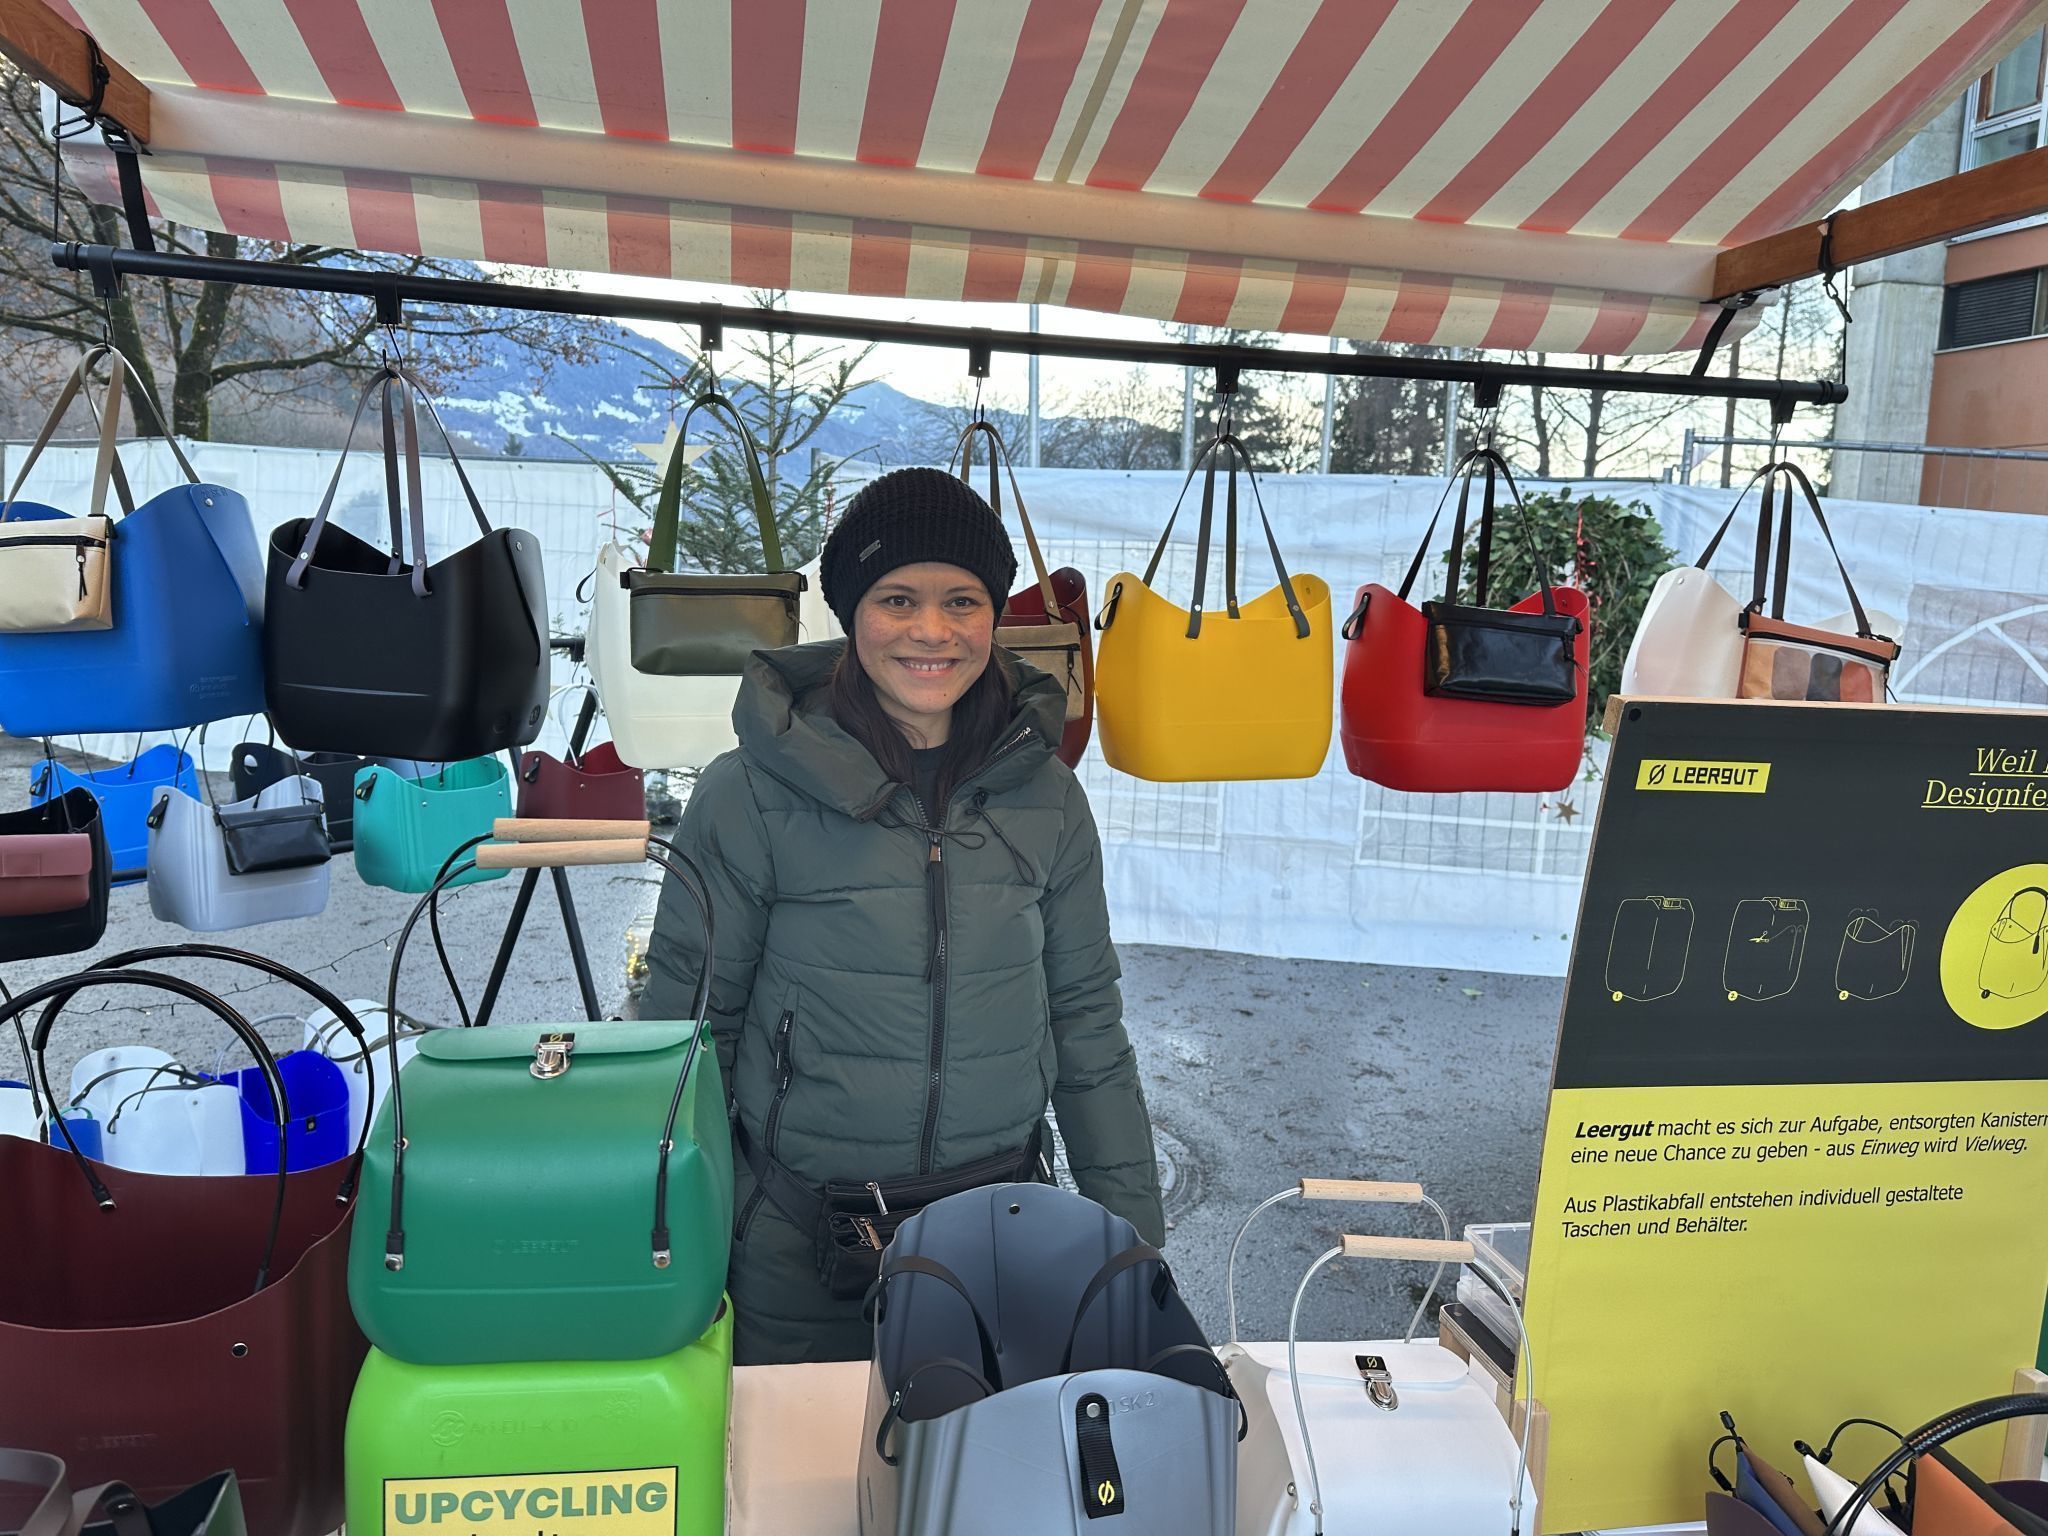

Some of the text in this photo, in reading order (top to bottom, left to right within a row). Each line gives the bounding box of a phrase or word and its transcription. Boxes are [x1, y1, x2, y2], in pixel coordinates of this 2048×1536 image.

[1976, 747, 2038, 774] Weil
[1923, 779, 2048, 813] Designfe
[1576, 1120, 1654, 1141] Leergut
[1658, 1118, 1711, 1136] macht
[1717, 1122, 1736, 1135] es
[1741, 1117, 1773, 1135] sich
[1779, 1120, 1807, 1133] zur
[1810, 1114, 1883, 1136] Aufgabe,
[1890, 1112, 1975, 1133] entsorgten
[1571, 1148, 1609, 1163] eine
[1615, 1149, 1657, 1163] neue
[1664, 1143, 1726, 1161] Chance
[1731, 1146, 1751, 1159] zu
[1756, 1141, 1808, 1163] geben
[1827, 1143, 1855, 1157] aus
[1861, 1139, 1919, 1158] Einweg
[1924, 1136, 1959, 1153] wird
[1966, 1135, 2028, 1155] Vielweg.
[1564, 1185, 1963, 1214] Aus Plastikabfall entstehen individuell gestaltete
[1562, 1215, 1748, 1238] Taschen und Behälter.
[394, 1481, 669, 1525] UPCYCLING
